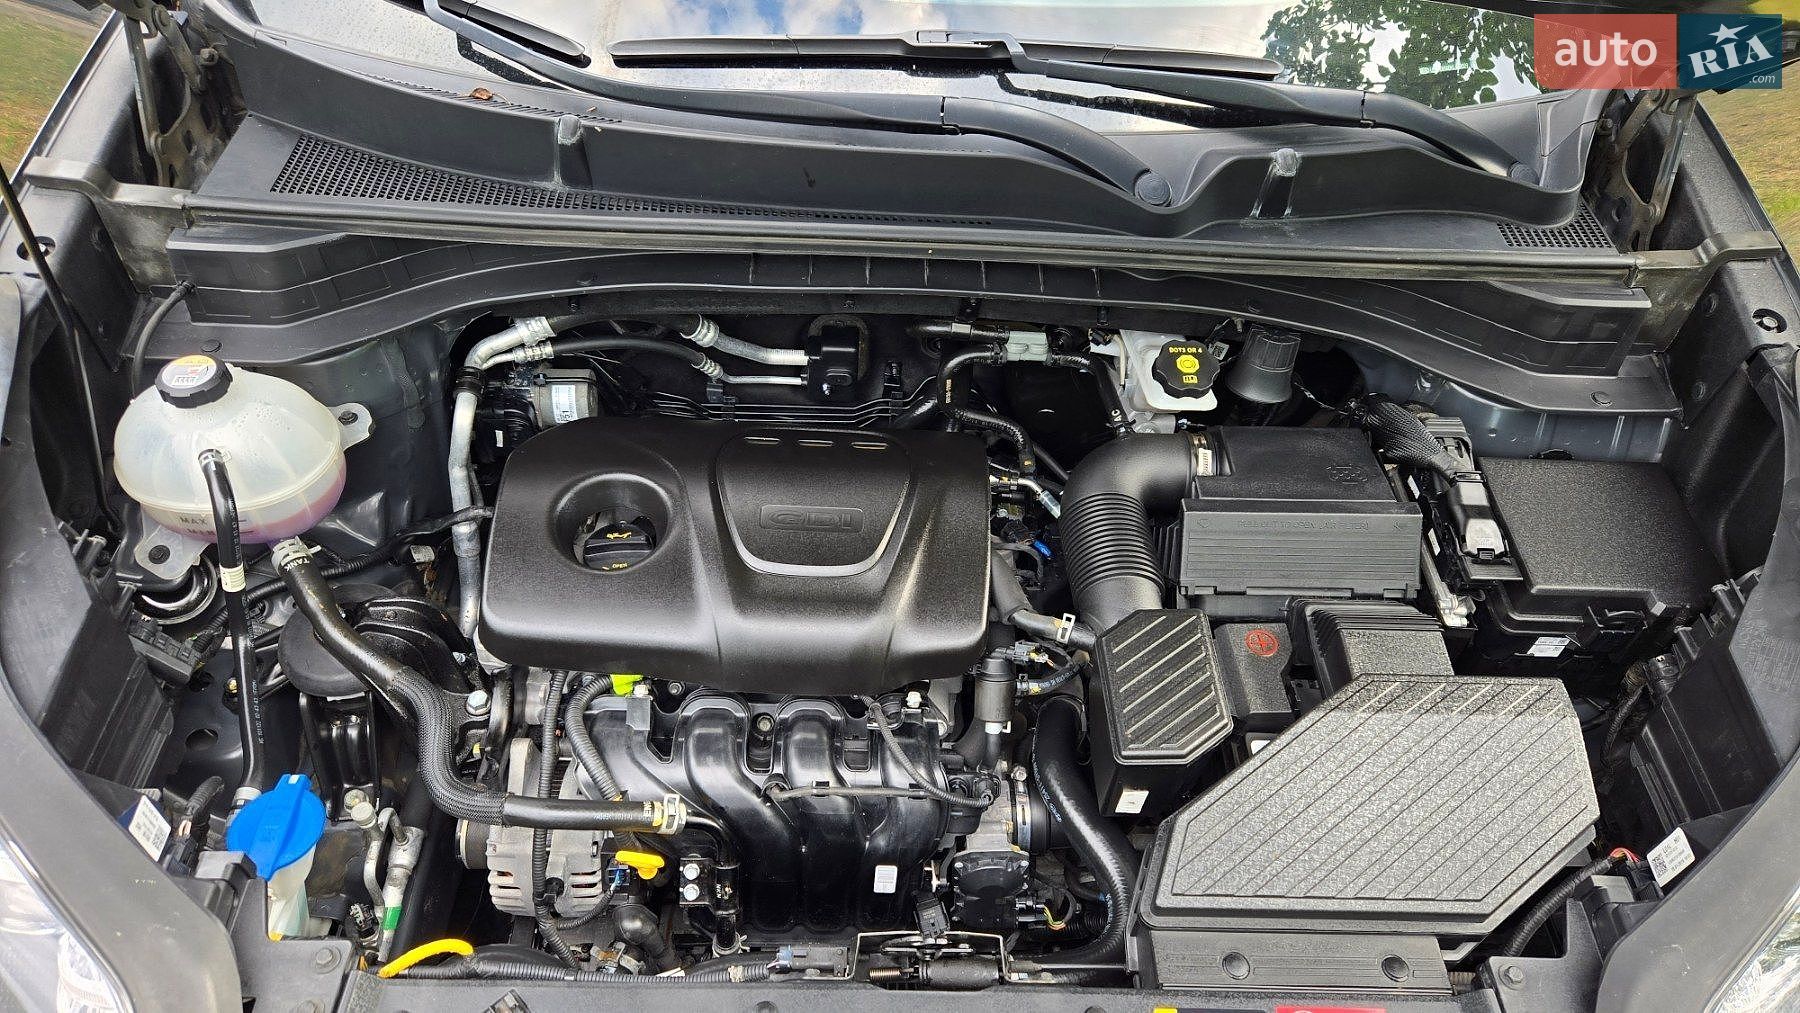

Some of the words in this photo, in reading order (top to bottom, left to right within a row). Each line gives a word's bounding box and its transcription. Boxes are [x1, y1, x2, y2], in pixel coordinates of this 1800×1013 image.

[1187, 346, 1198, 354] OR
[180, 516, 207, 525] MAX
[767, 508, 853, 530] GDI
[284, 557, 310, 572] TANK
